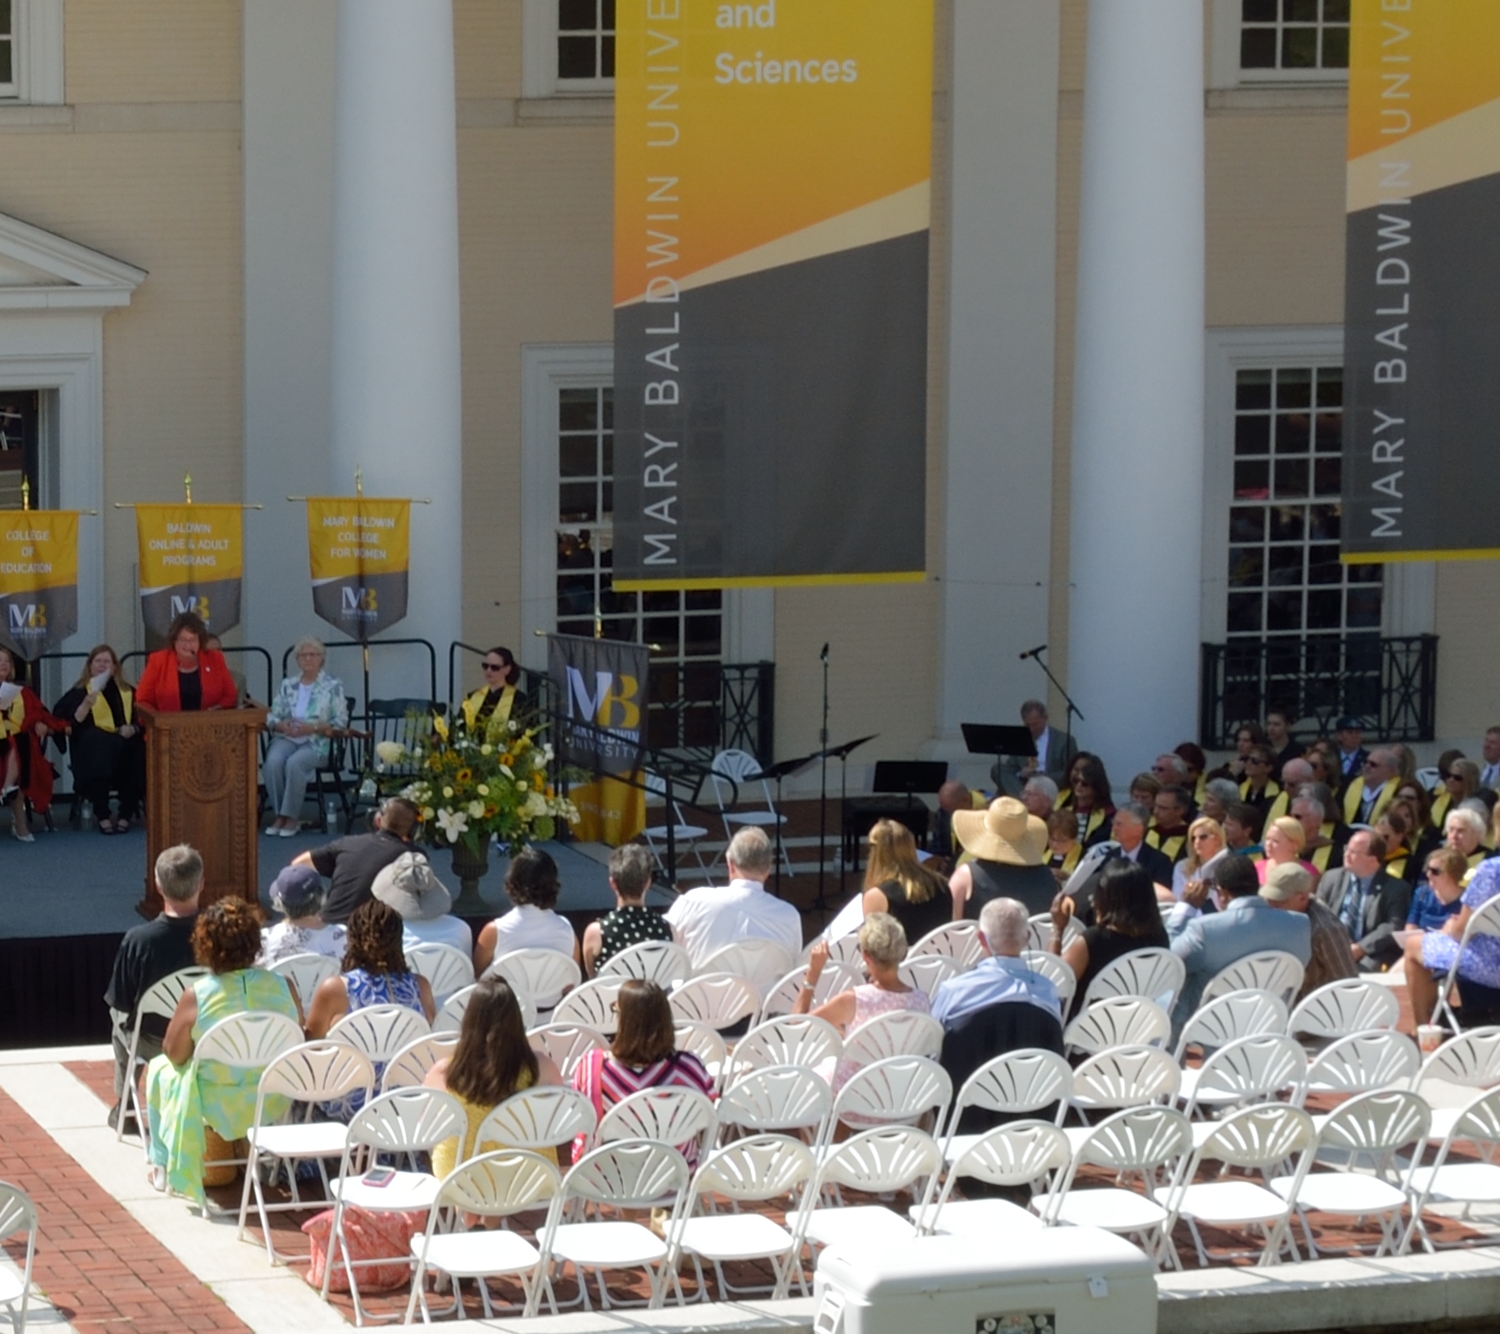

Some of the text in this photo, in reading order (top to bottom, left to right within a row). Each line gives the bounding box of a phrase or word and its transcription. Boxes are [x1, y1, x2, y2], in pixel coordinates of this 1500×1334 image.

[714, 52, 858, 86] Sciences
[1374, 160, 1411, 384] BALDWIN
[645, 174, 681, 406] BALDWIN
[1370, 409, 1403, 539] MARY
[642, 431, 680, 567] MARY
[167, 523, 211, 534] BALDWIN
[323, 516, 395, 529] MARY BALDWIN
[6, 531, 49, 541] COLLEGE
[338, 532, 379, 543] COLLEGE
[149, 539, 229, 551] ONLINE & ADULT
[22, 546, 34, 557] OF
[330, 548, 386, 559] FOR WOMEN
[162, 556, 216, 566] PROGRAMS
[0, 563, 52, 574] EDUCATION
[566, 665, 640, 729] MB
